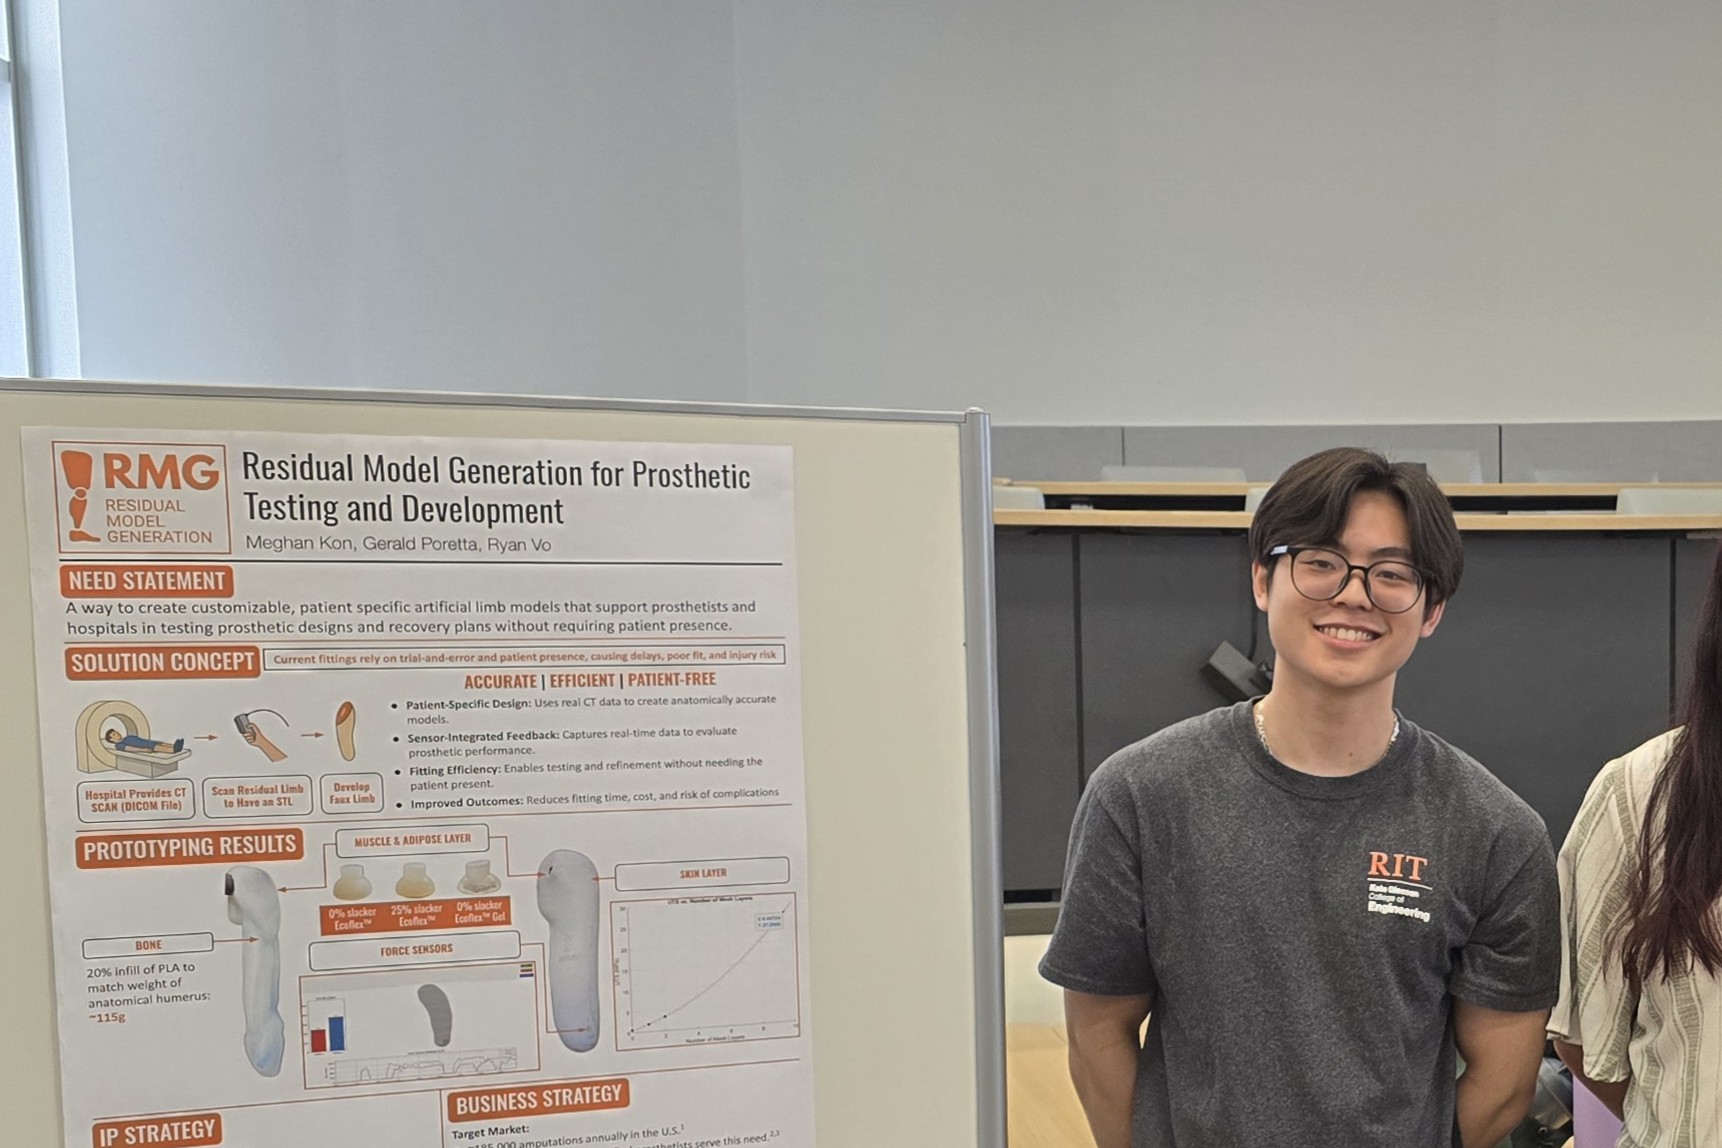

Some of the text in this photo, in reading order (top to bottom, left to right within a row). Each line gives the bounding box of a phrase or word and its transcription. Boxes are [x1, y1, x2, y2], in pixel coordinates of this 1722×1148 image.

[103, 452, 224, 491] RMG
[242, 451, 750, 489] Residual Model Generation for Prosthetic
[105, 498, 186, 512] RESIDUAL
[243, 491, 564, 529] Testing and Development
[106, 514, 165, 528] MODEL
[107, 530, 212, 543] GENERATION
[246, 535, 552, 555] Meghan Kon, Gerald Poretta, Ryan Vo
[69, 571, 226, 590] NEED STATEMENT
[65, 600, 756, 617] A way to create customizable, patient specific artificial limb models that support prosthetists and
[67, 619, 732, 637] hospitals in testing prosthetic designs and recovery plans without requiring patient presence.
[71, 652, 255, 672] SOLUTION CONCEPT
[464, 672, 717, 689] ACCURATE EFFICIENT PATIENT-FREE
[85, 787, 187, 801] Hospital Provides CT
[211, 784, 304, 796] Scan Residual Limb
[333, 781, 370, 793] Develop
[223, 799, 234, 808] to
[236, 797, 260, 807] Have
[276, 796, 294, 806] STL
[329, 793, 376, 804] Faux Limb
[91, 800, 182, 813] SCAN (DICOM File)
[83, 834, 296, 861] PROTOTYPING RESULTS
[354, 833, 472, 847] MUSCLE & ADIPOSE LAYER
[680, 868, 727, 879] SKIN LAYER
[1367, 852, 1428, 880] RIT
[328, 908, 377, 919] 0% slacker
[391, 904, 443, 915] 25% slacker
[456, 901, 503, 912] 0% slacker
[1368, 900, 1431, 922] Engineering
[135, 939, 162, 950] BONE
[380, 943, 453, 957] FORCE SENSORS
[86, 963, 195, 978] 20% infill of PLA to
[87, 976, 182, 993] match weight of
[88, 992, 211, 1008] anatomical humerus:
[88, 1012, 126, 1023] ~115g
[456, 1083, 622, 1115] BUSINESS STRATEGY
[100, 1119, 215, 1147] IP STRATEGY
[451, 1125, 530, 1140] Target Market:
